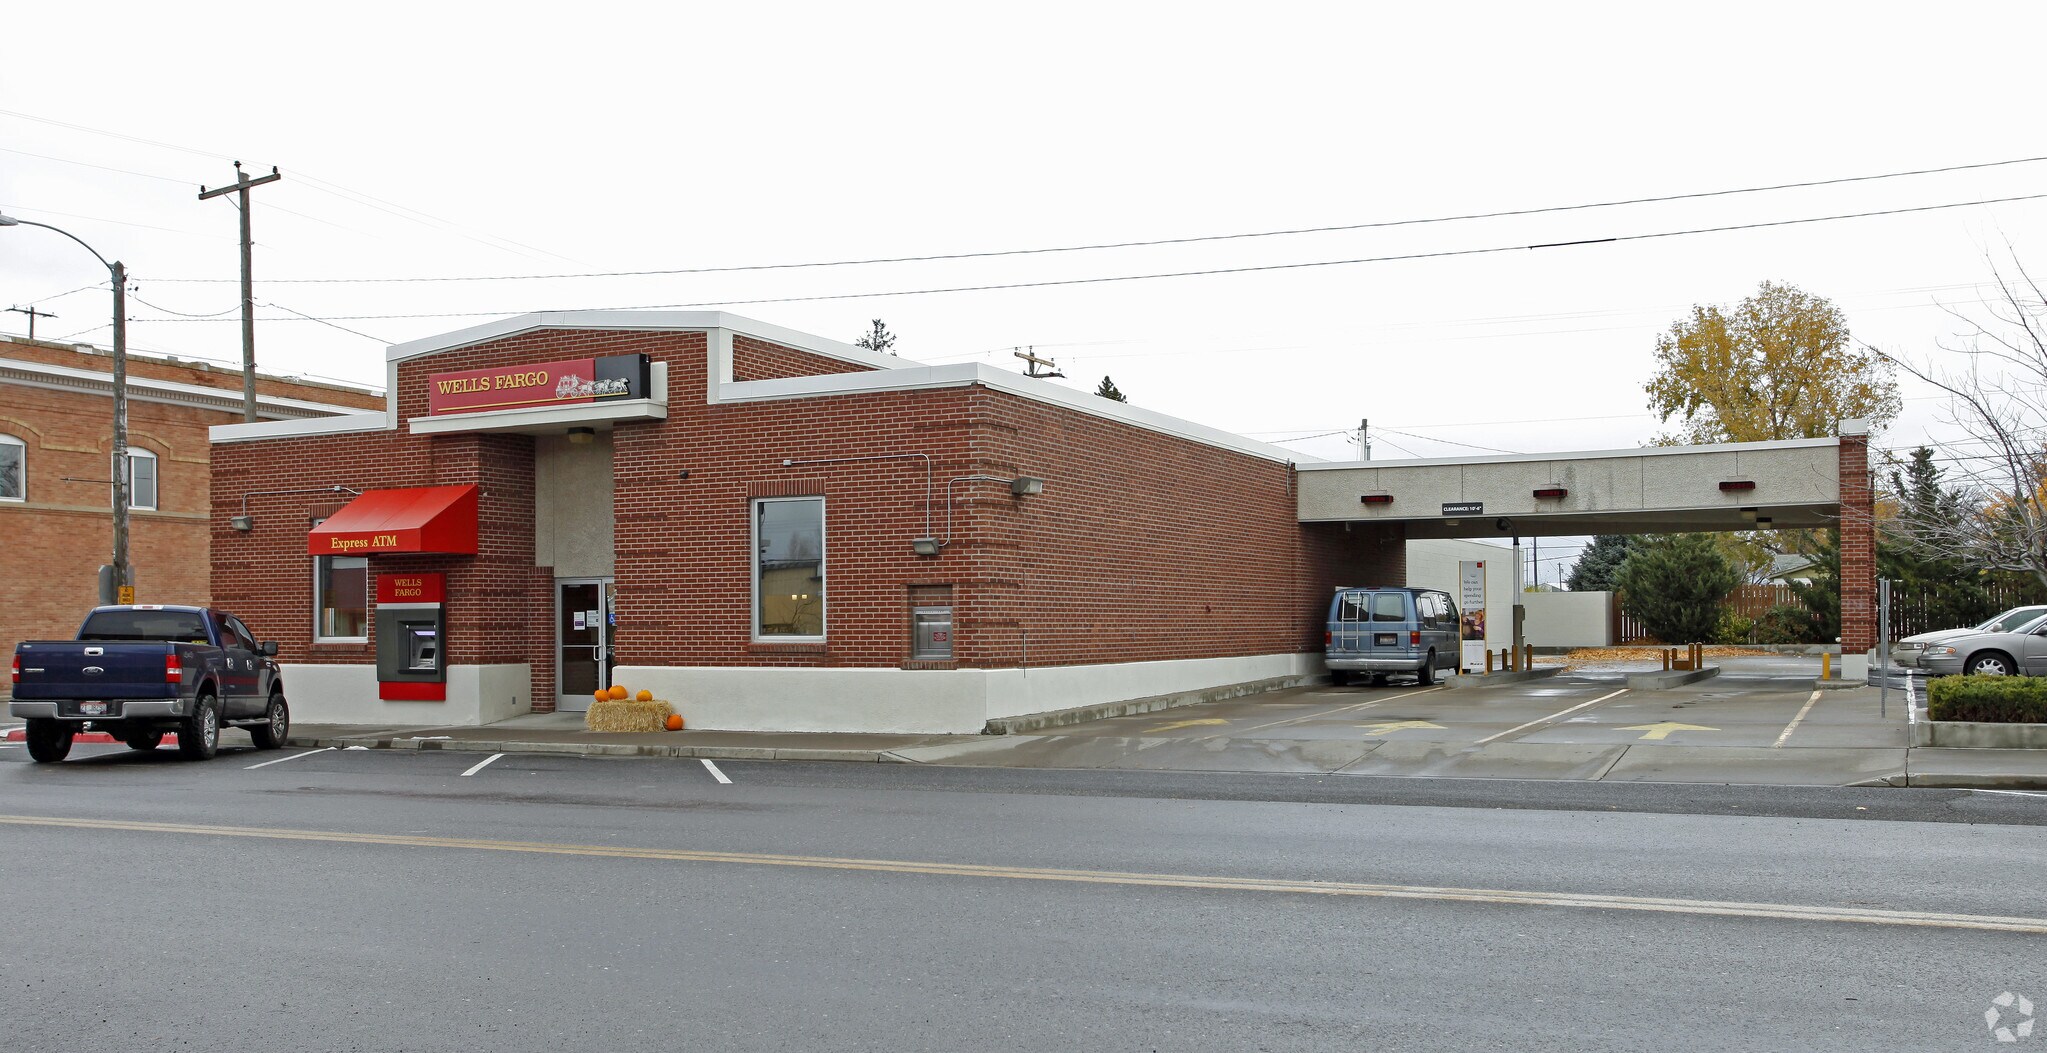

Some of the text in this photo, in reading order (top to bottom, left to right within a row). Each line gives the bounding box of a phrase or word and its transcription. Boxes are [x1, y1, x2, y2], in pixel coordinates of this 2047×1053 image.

[437, 371, 548, 395] WELLS FARGO
[331, 535, 397, 552] Express ATM
[394, 578, 422, 587] WELLS
[394, 588, 422, 597] FARGO
